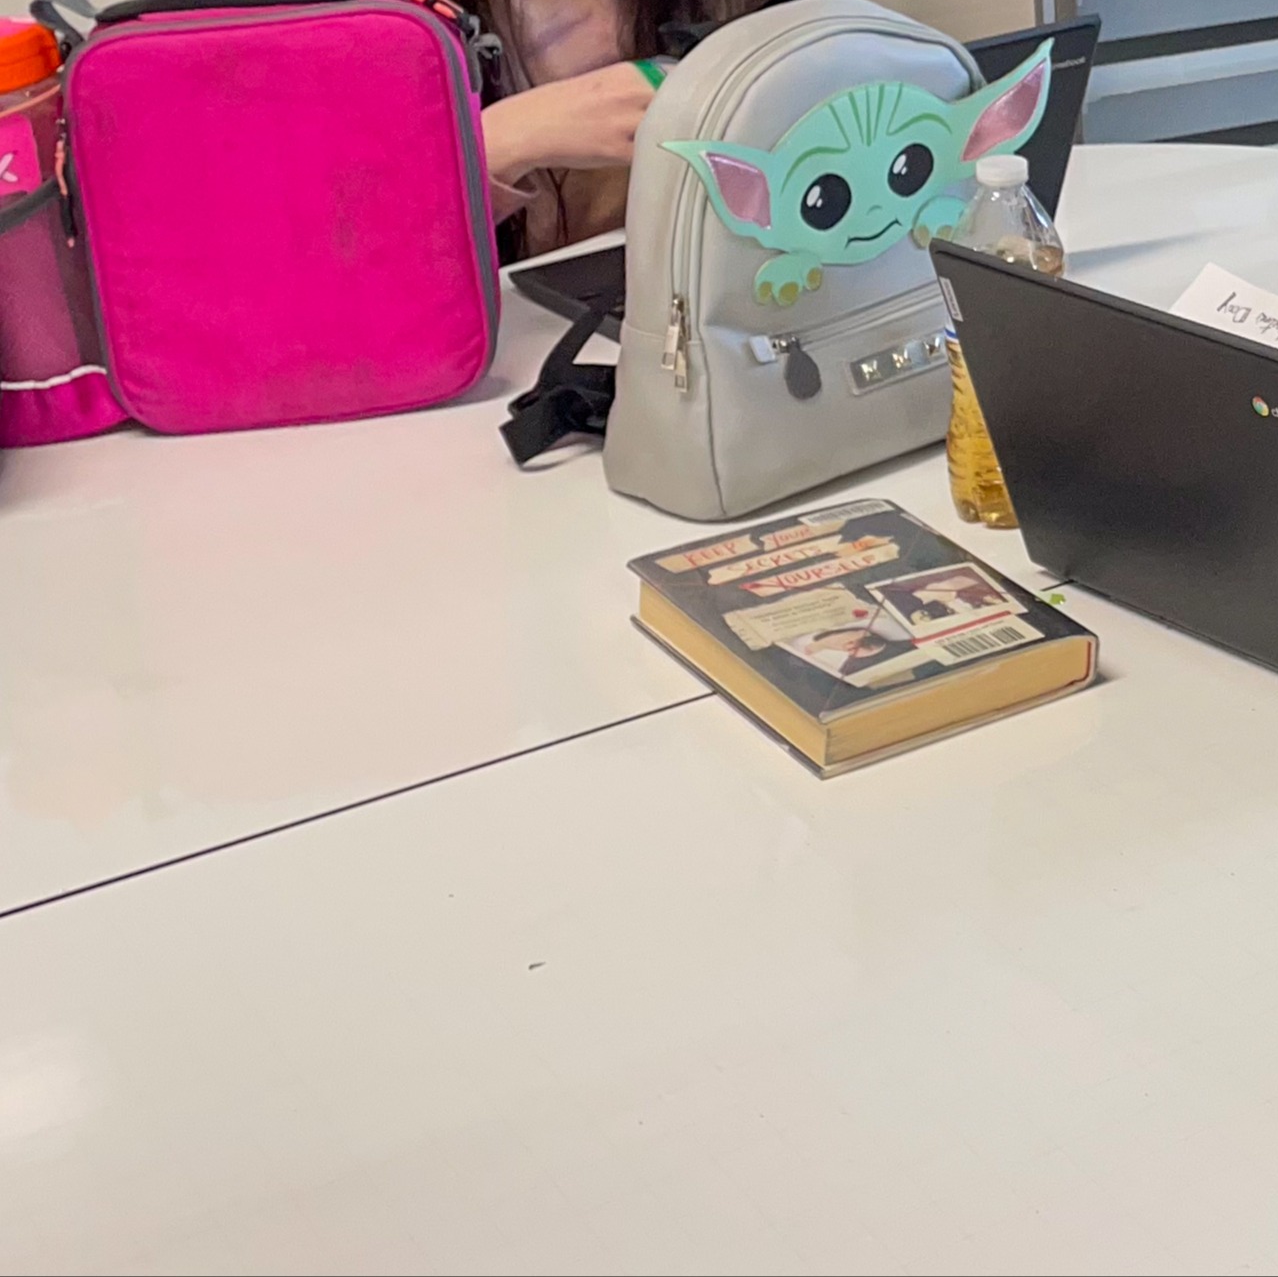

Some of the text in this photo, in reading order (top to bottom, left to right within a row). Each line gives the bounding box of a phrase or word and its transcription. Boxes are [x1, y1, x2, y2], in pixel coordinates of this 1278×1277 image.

[1216, 292, 1252, 324] Day
[684, 542, 738, 568] KEEP
[727, 545, 822, 577] SECRETS
[767, 554, 877, 591] YOURSELF
